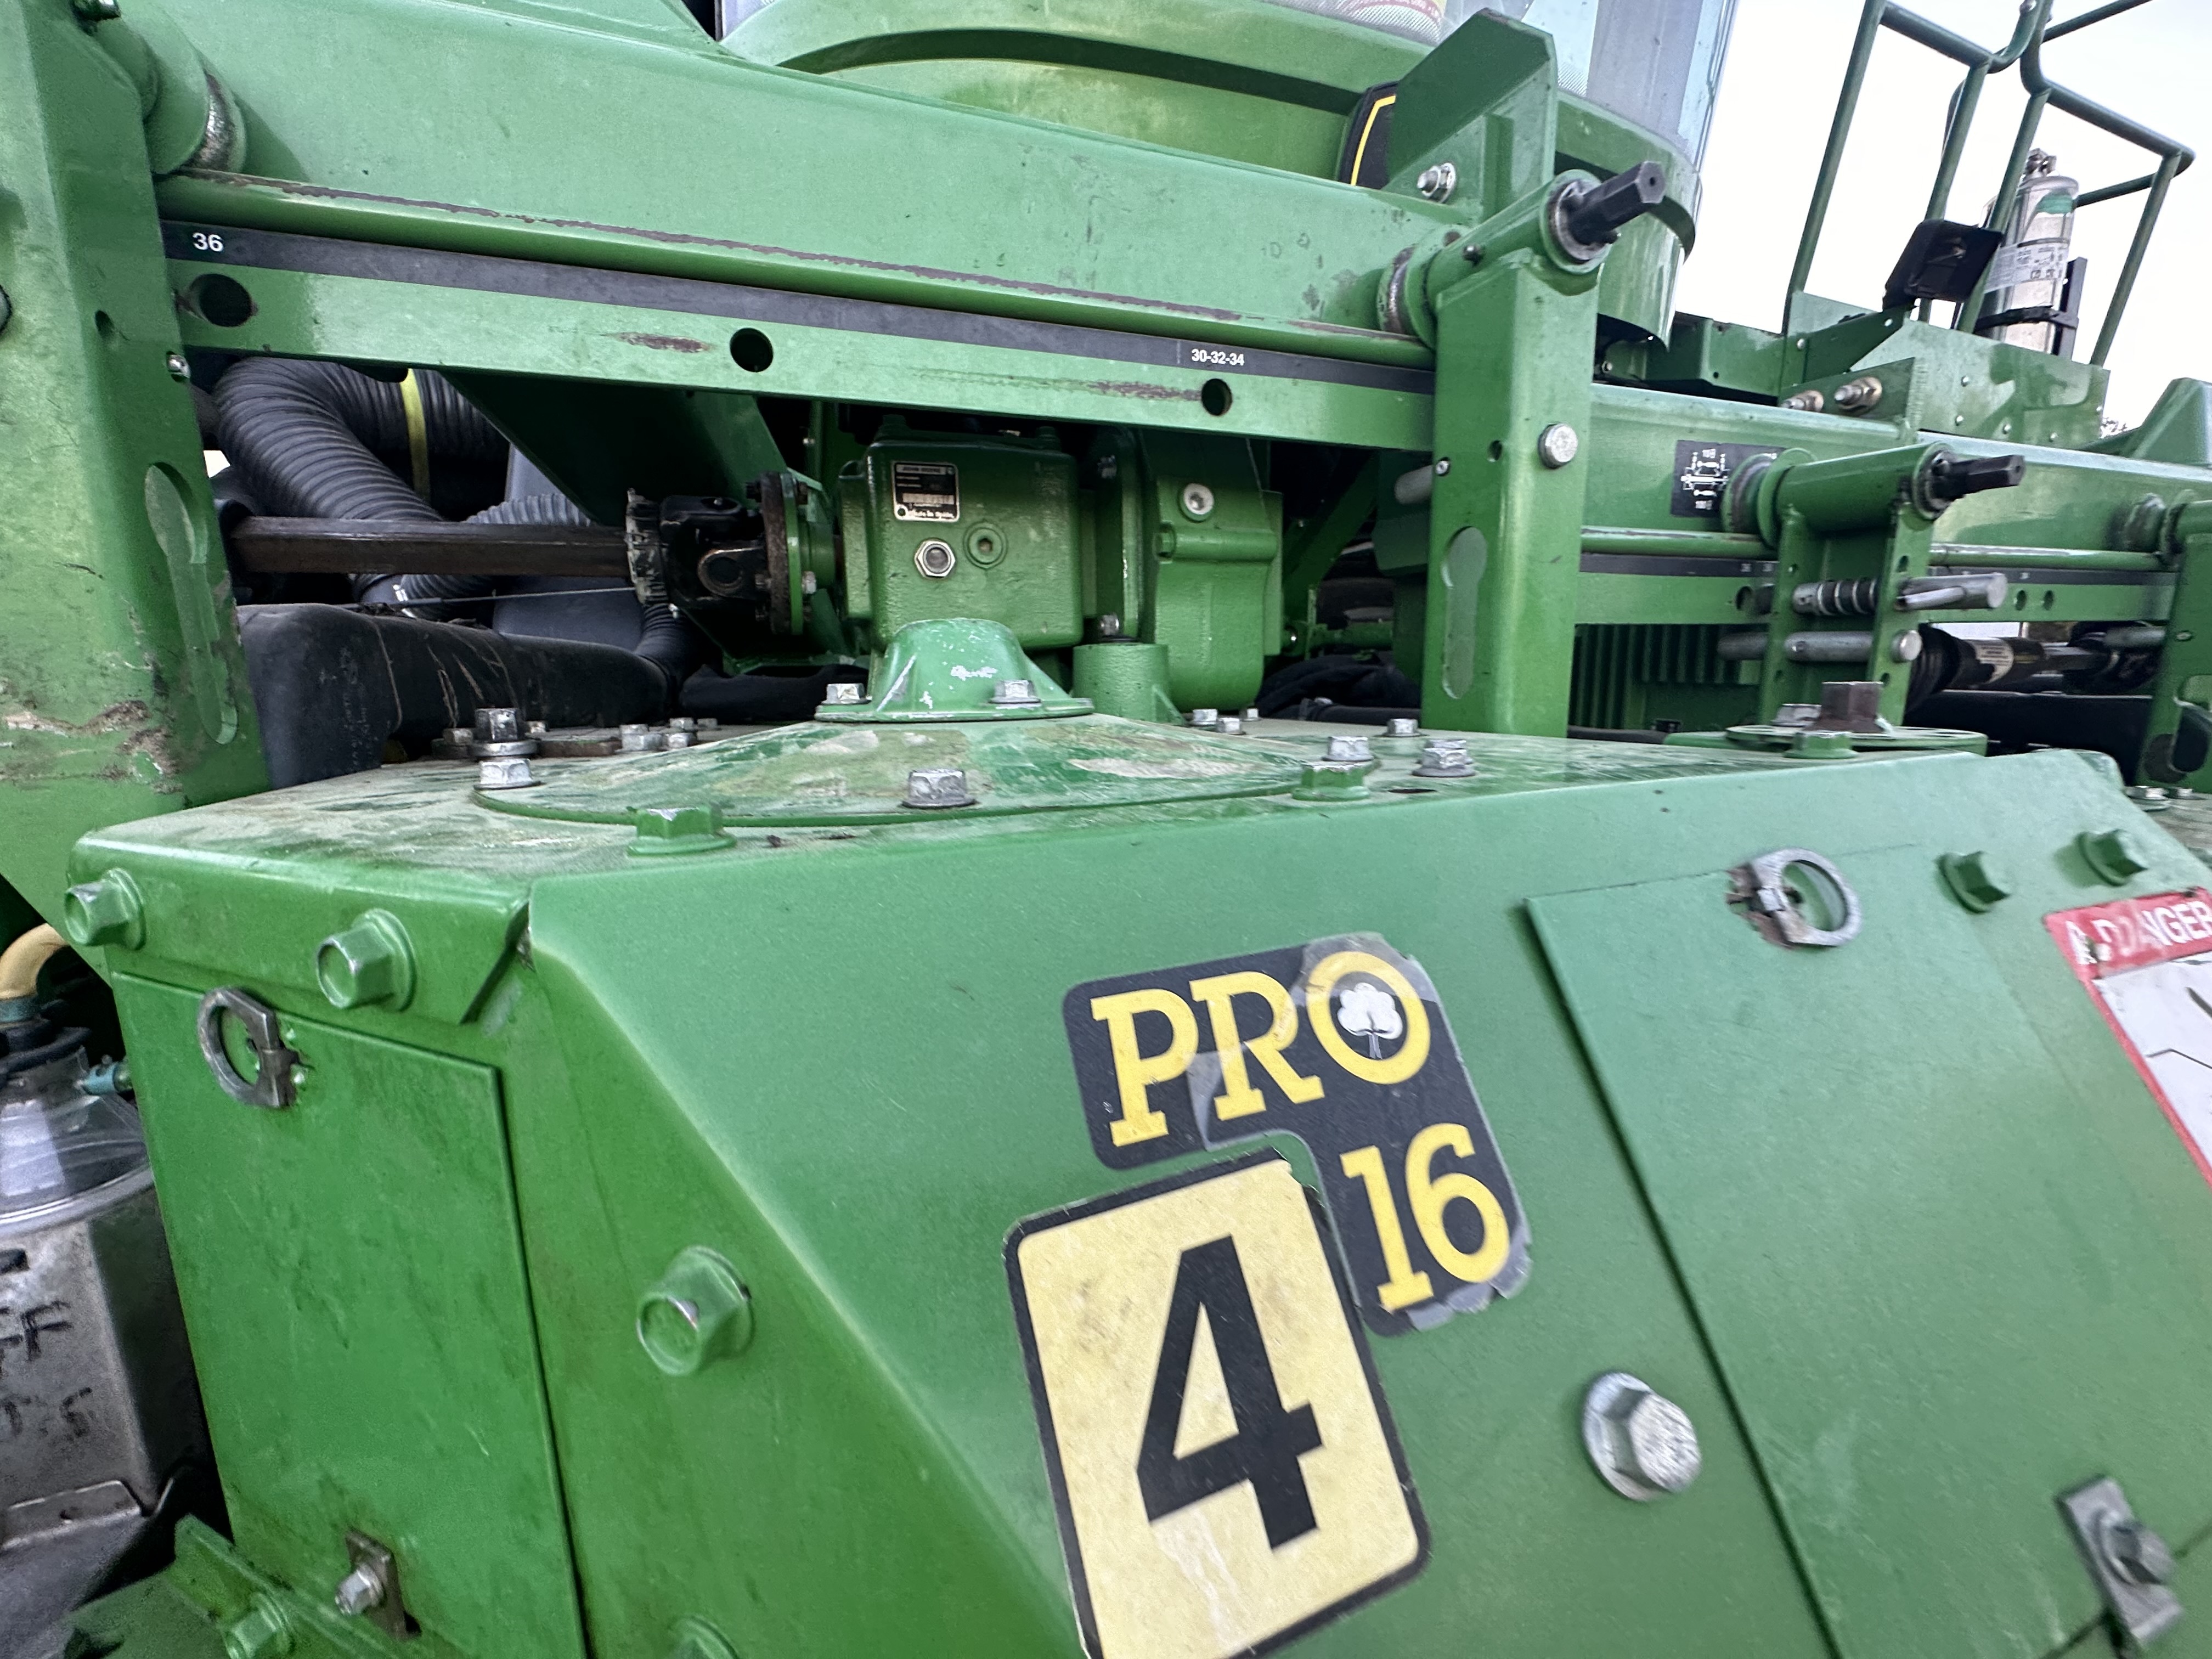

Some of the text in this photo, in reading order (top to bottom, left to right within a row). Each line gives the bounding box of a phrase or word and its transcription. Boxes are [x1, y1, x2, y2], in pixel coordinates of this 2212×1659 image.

[192, 232, 224, 252] 36
[1191, 348, 1245, 366] 30-32-34
[1091, 951, 1431, 1147] PRO
[1340, 1122, 1510, 1313] 16
[1137, 1233, 1327, 1551] 4
